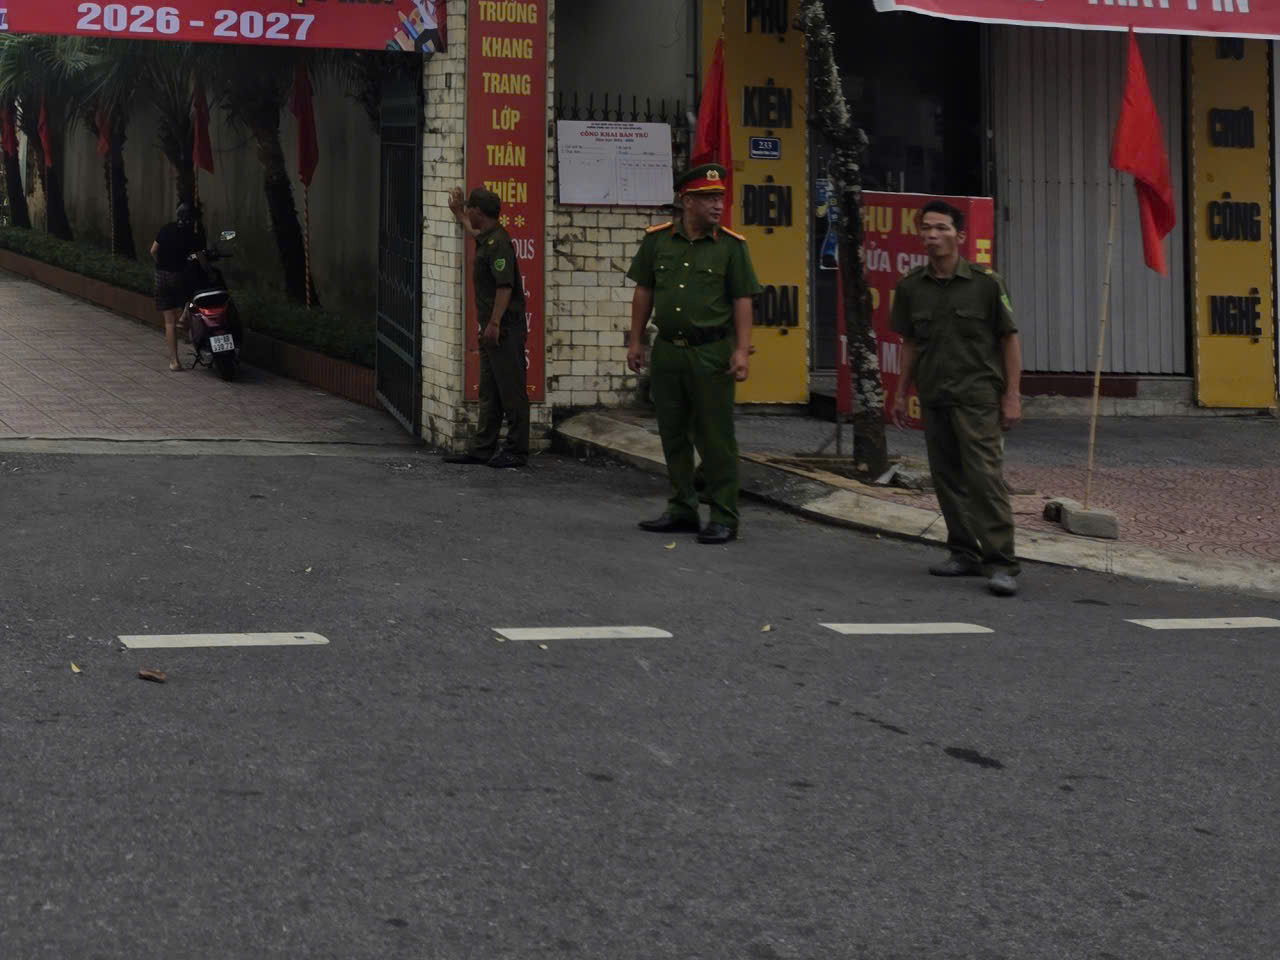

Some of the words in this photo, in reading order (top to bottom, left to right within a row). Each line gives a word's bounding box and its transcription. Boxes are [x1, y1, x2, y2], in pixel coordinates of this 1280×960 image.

[76, 1, 181, 34] 2026
[214, 8, 316, 41] 2027
[481, 36, 533, 60] KHANG
[482, 72, 531, 96] TRANG
[491, 105, 520, 131] LỚP
[743, 78, 792, 136] KIỆN
[486, 141, 526, 168] THÂN
[743, 175, 792, 234] ĐIỆN
[863, 206, 893, 238] HỤ
[1208, 192, 1261, 242] CÔNG
[866, 241, 892, 273] ỬA
[752, 284, 799, 336] HOẠI
[1209, 288, 1262, 344] NGHỆ
